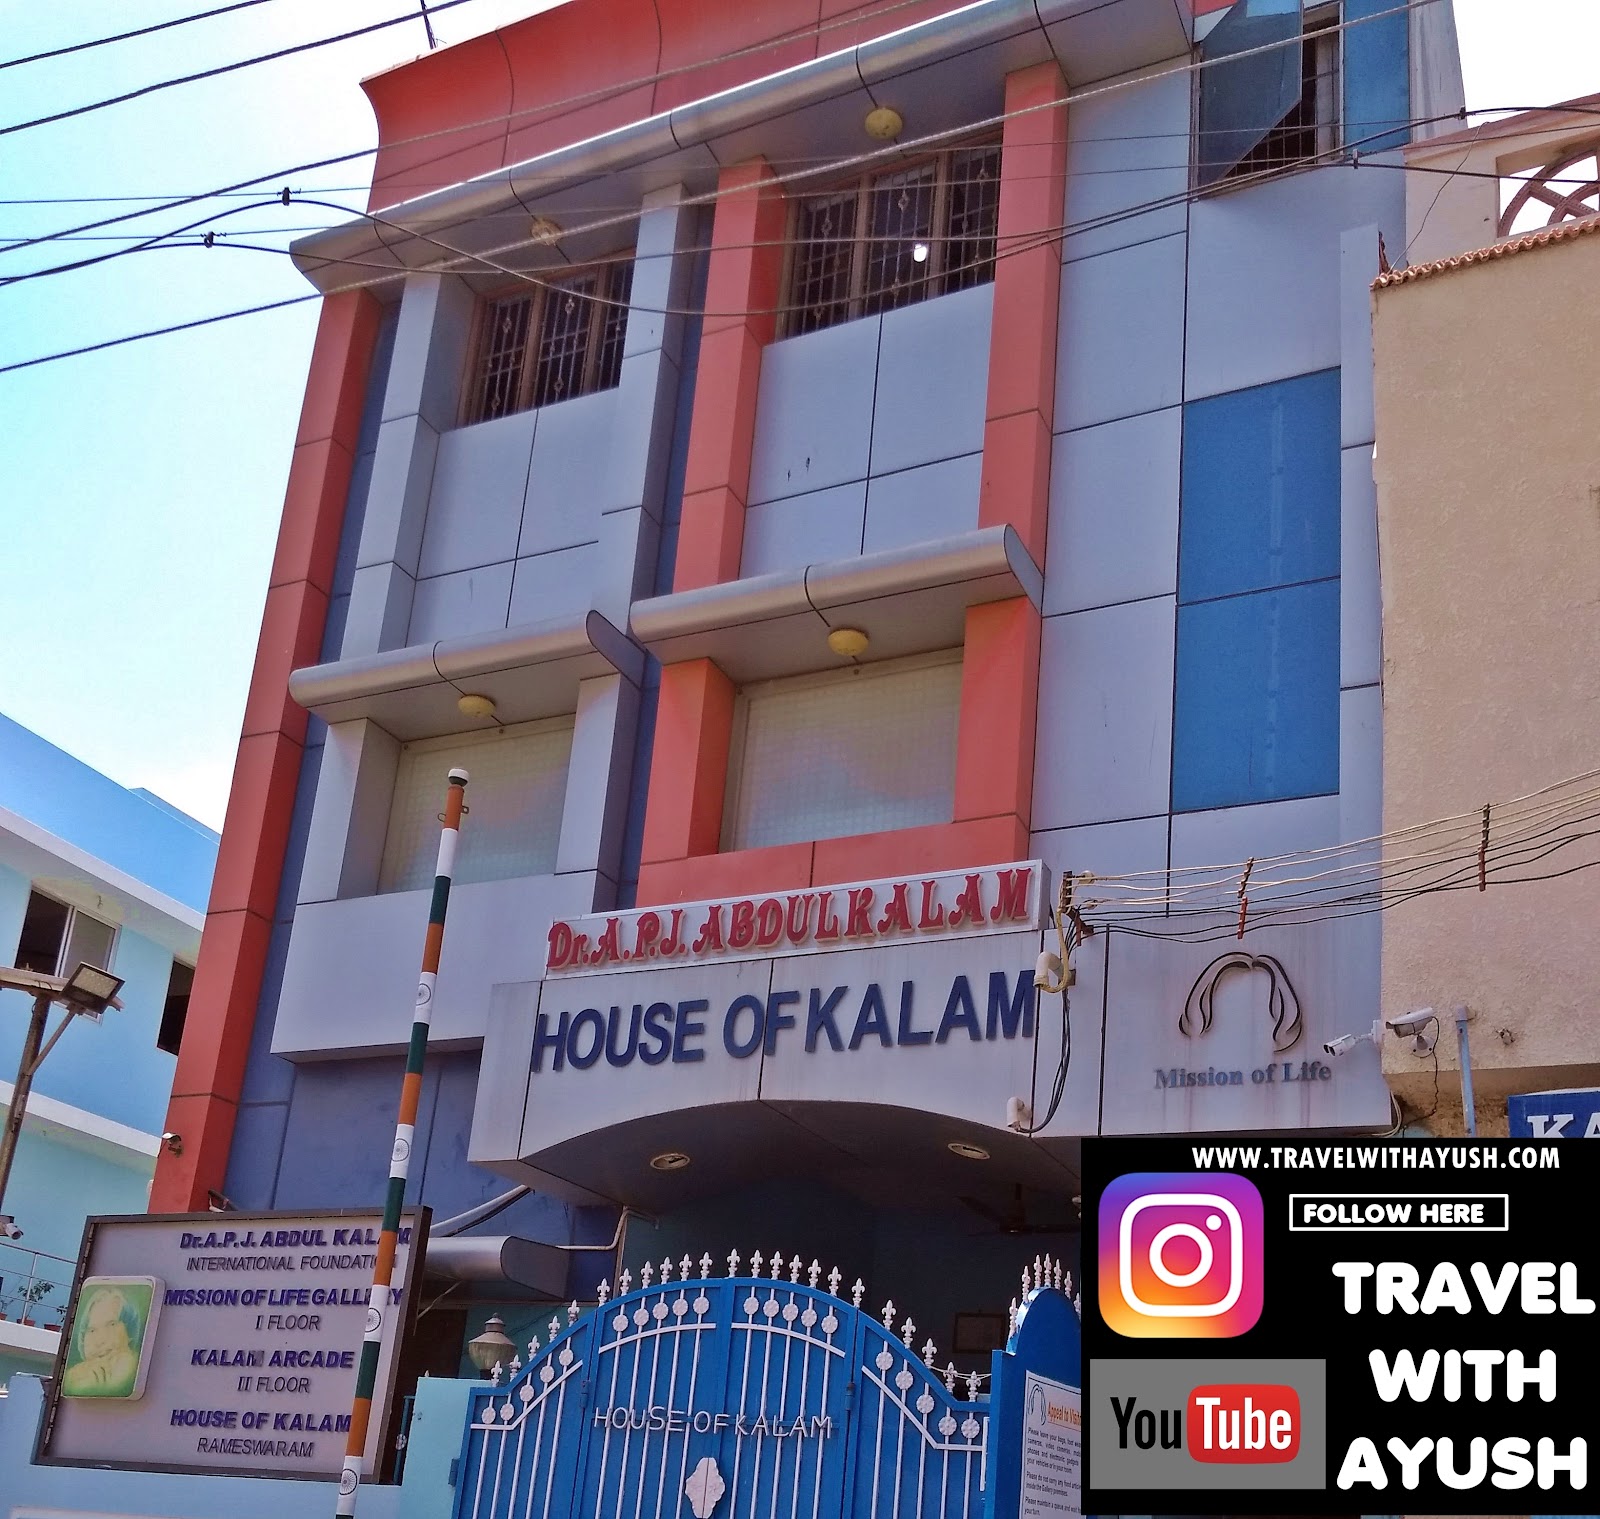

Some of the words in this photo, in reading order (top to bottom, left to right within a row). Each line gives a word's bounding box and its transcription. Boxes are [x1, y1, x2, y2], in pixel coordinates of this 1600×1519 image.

[531, 999, 708, 1073] HOUSE
[722, 991, 800, 1059] OF
[804, 969, 1036, 1053] KALAM
[1154, 1066, 1243, 1089] Mission
[1251, 1063, 1277, 1085] of
[1282, 1061, 1332, 1083] Life
[260, 1229, 326, 1247] ABDUL
[332, 1228, 412, 1246] KALM
[186, 1256, 296, 1271] INTERNATIONAL
[300, 1254, 397, 1270] FOUNDATI
[164, 1289, 239, 1306] MISSION
[240, 1289, 267, 1306] OF
[268, 1288, 309, 1306] LIFE
[255, 1315, 263, 1330] I
[267, 1314, 320, 1331] FLOOR
[268, 1350, 355, 1368] ARCADE
[237, 1376, 252, 1391] II
[255, 1376, 311, 1393] FLOOR
[170, 1410, 238, 1428] HOUSE
[241, 1412, 270, 1430] OF
[273, 1413, 352, 1433] KALAM
[1048, 1401, 1064, 1422] Appeal
[593, 1406, 685, 1433] HOUSE
[693, 1411, 731, 1435] OF
[734, 1413, 833, 1440] KALAM
[197, 1437, 315, 1458] RAMESWARAM
